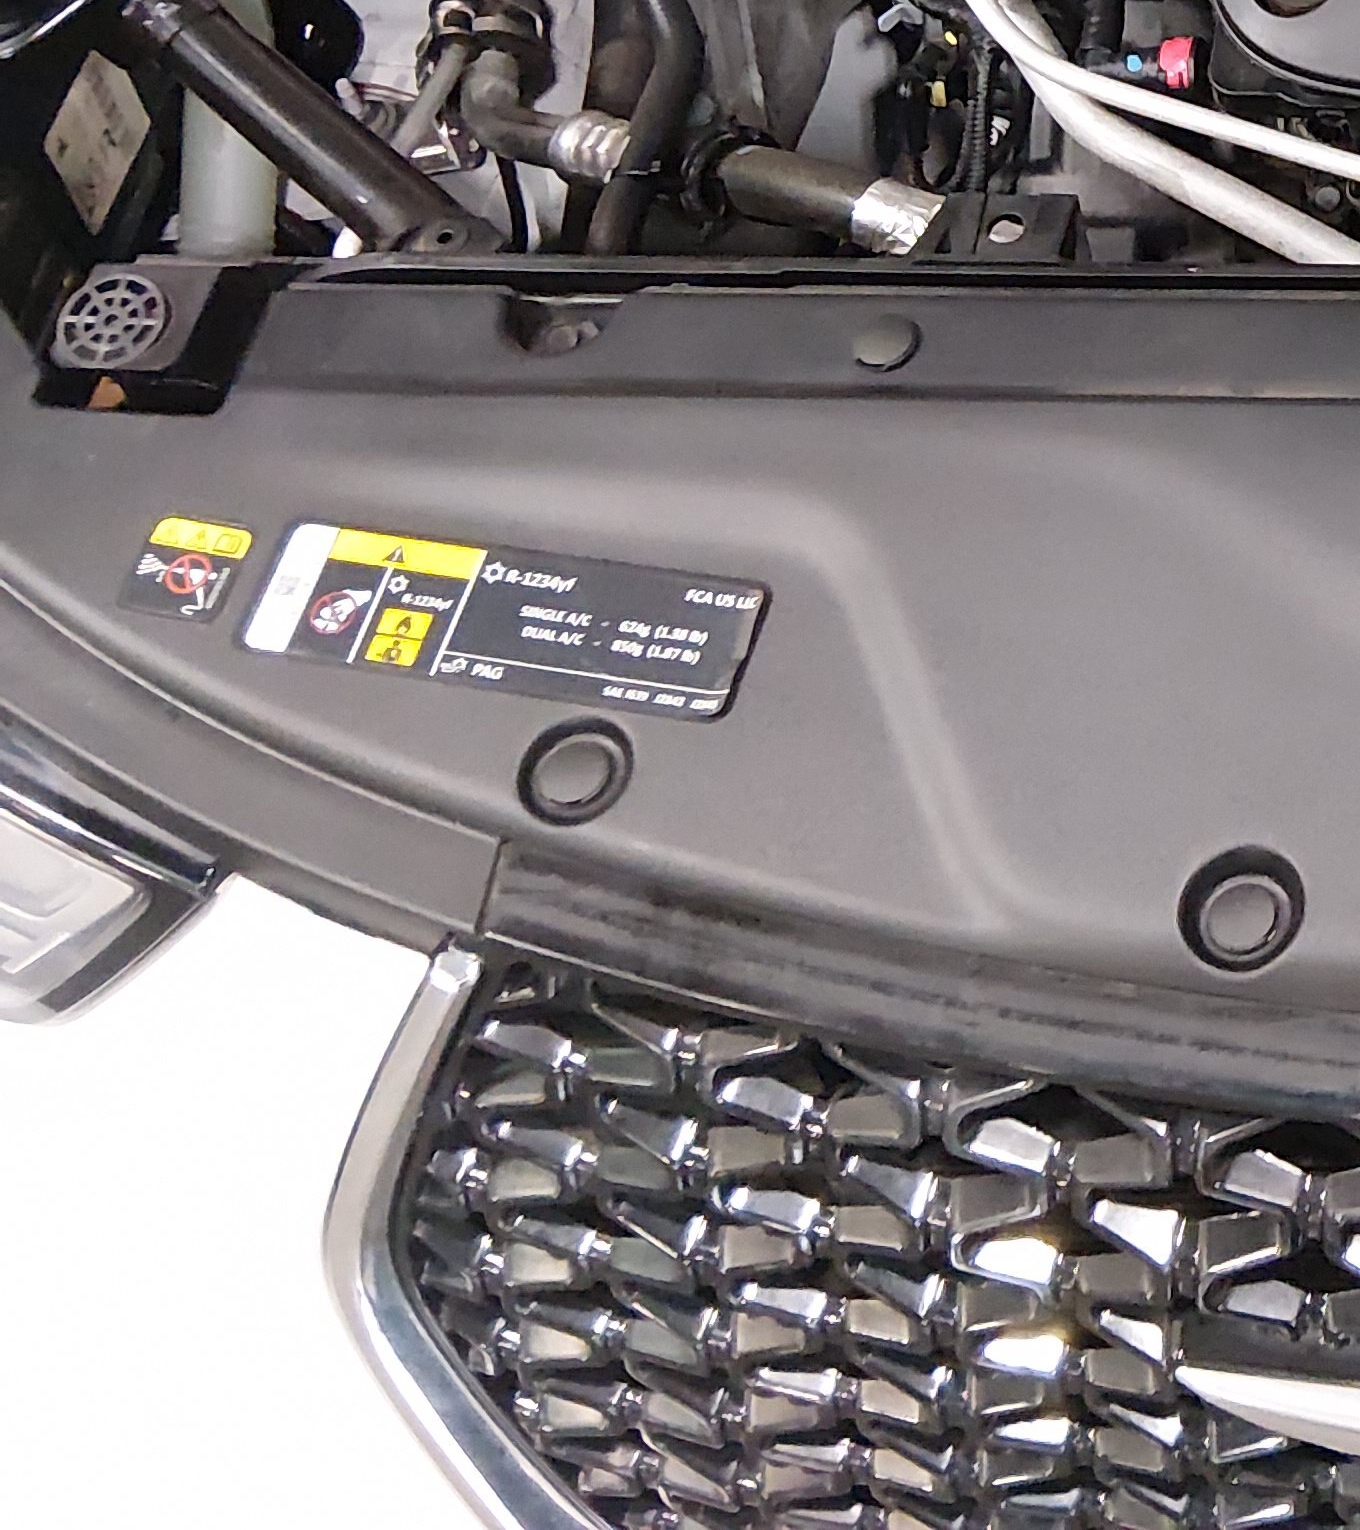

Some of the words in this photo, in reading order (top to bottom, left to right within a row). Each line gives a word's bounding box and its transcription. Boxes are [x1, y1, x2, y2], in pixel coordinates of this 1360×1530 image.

[504, 569, 579, 594] R-1234yf
[684, 588, 713, 604] FCA
[715, 593, 737, 607] US
[518, 604, 568, 622] SINGLE
[564, 613, 593, 627] A/C
[520, 625, 558, 641] DUAL
[557, 631, 587, 646] A/C
[470, 663, 505, 680] PAG
